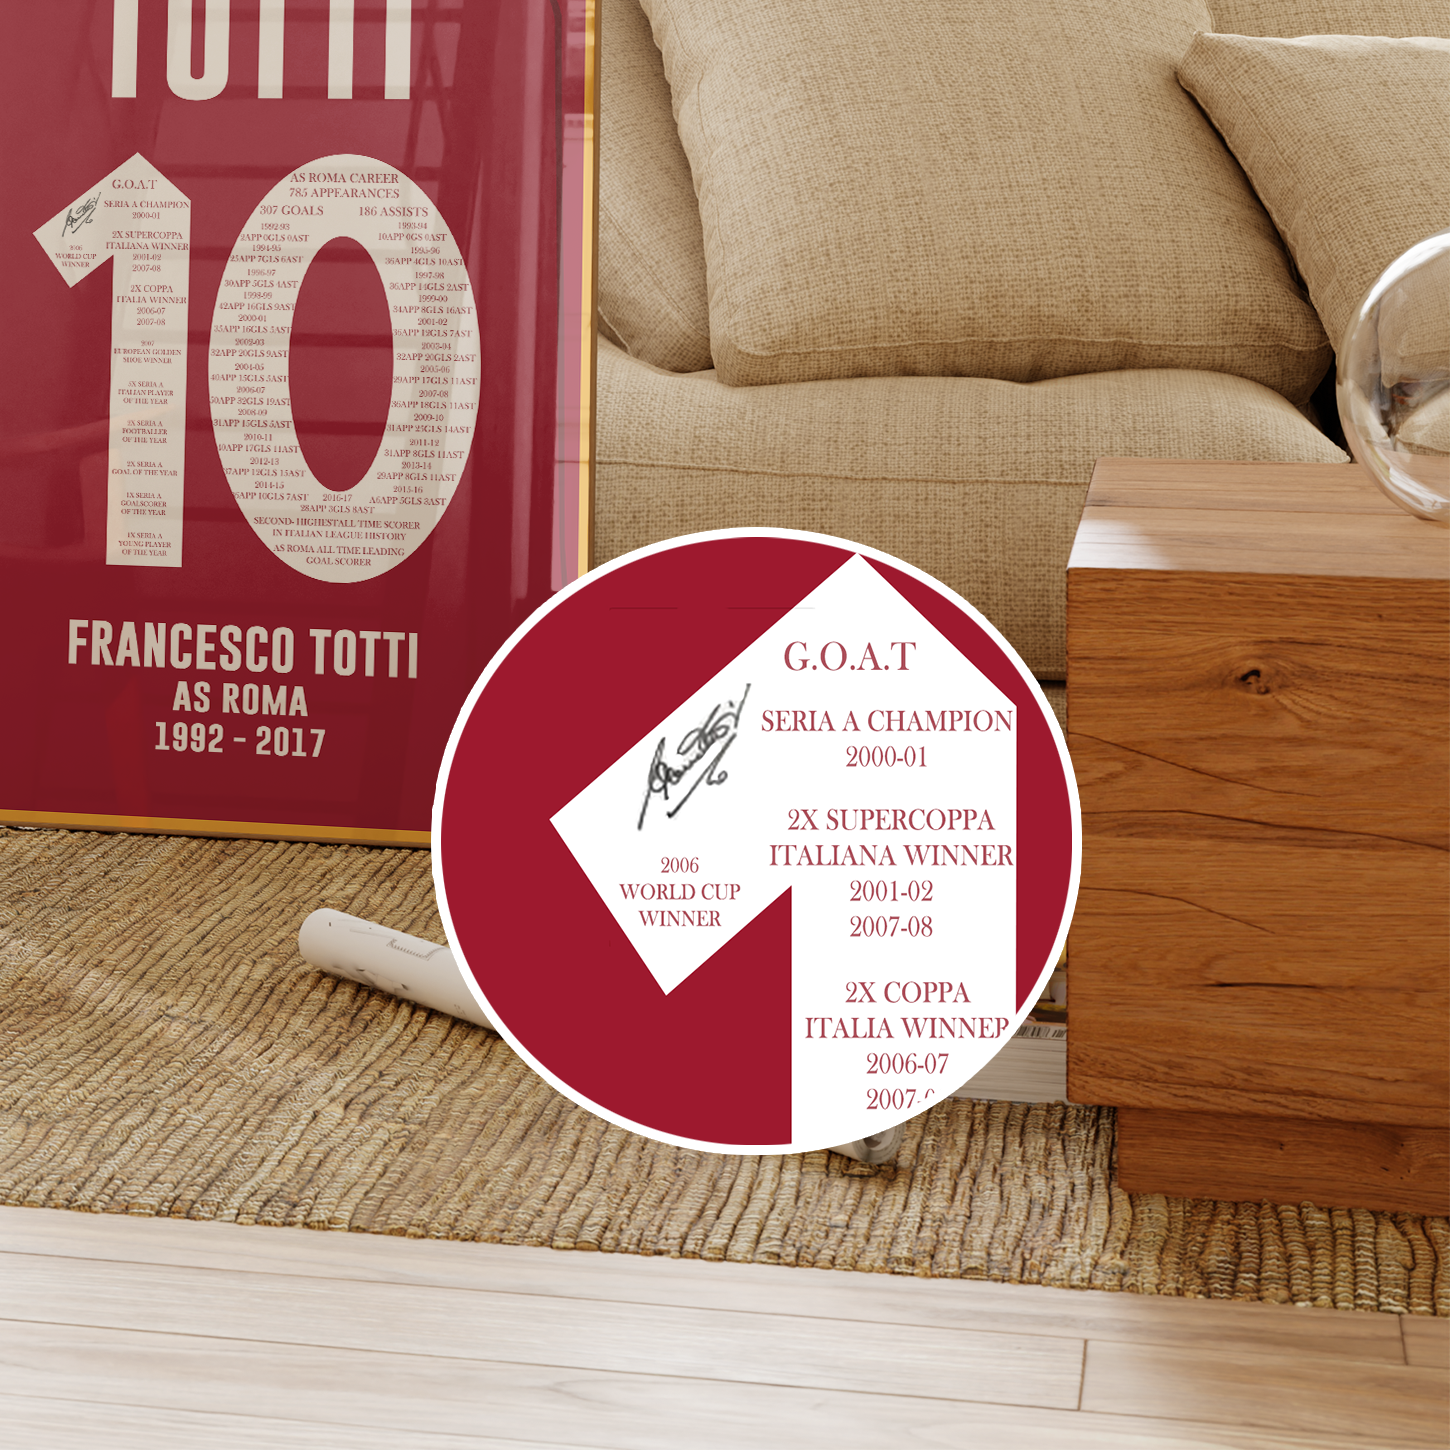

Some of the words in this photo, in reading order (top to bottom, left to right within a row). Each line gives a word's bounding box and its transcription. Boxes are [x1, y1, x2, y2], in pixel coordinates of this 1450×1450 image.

[289, 173, 305, 182] AS
[309, 173, 346, 182] ROMA
[350, 173, 398, 183] CAREER
[112, 180, 157, 189] G.O.A.T
[290, 188, 307, 197] 785
[311, 188, 400, 198] APPEARANCES
[260, 205, 278, 215] 307
[282, 205, 323, 215] GOALS
[360, 206, 377, 216] 186
[380, 207, 428, 217] ASSISTS
[125, 231, 183, 239] SUPERCOPPA
[33, 152, 481, 584] 10
[254, 517, 294, 525] SECOND-
[297, 518, 356, 527] HIGHESTALL
[358, 520, 382, 528] TIME
[384, 521, 420, 529] SCORER
[365, 532, 406, 540] HISTORY
[273, 544, 285, 552] AS
[287, 545, 314, 553] ROMA
[337, 546, 360, 554] TIME
[363, 547, 404, 556] LEADING
[68, 620, 294, 674] FRANCESCO
[309, 629, 419, 679] TOTTI
[173, 681, 211, 713] AS
[223, 683, 308, 717] ROMA
[155, 722, 224, 753] 1992
[256, 726, 326, 758] 2017
